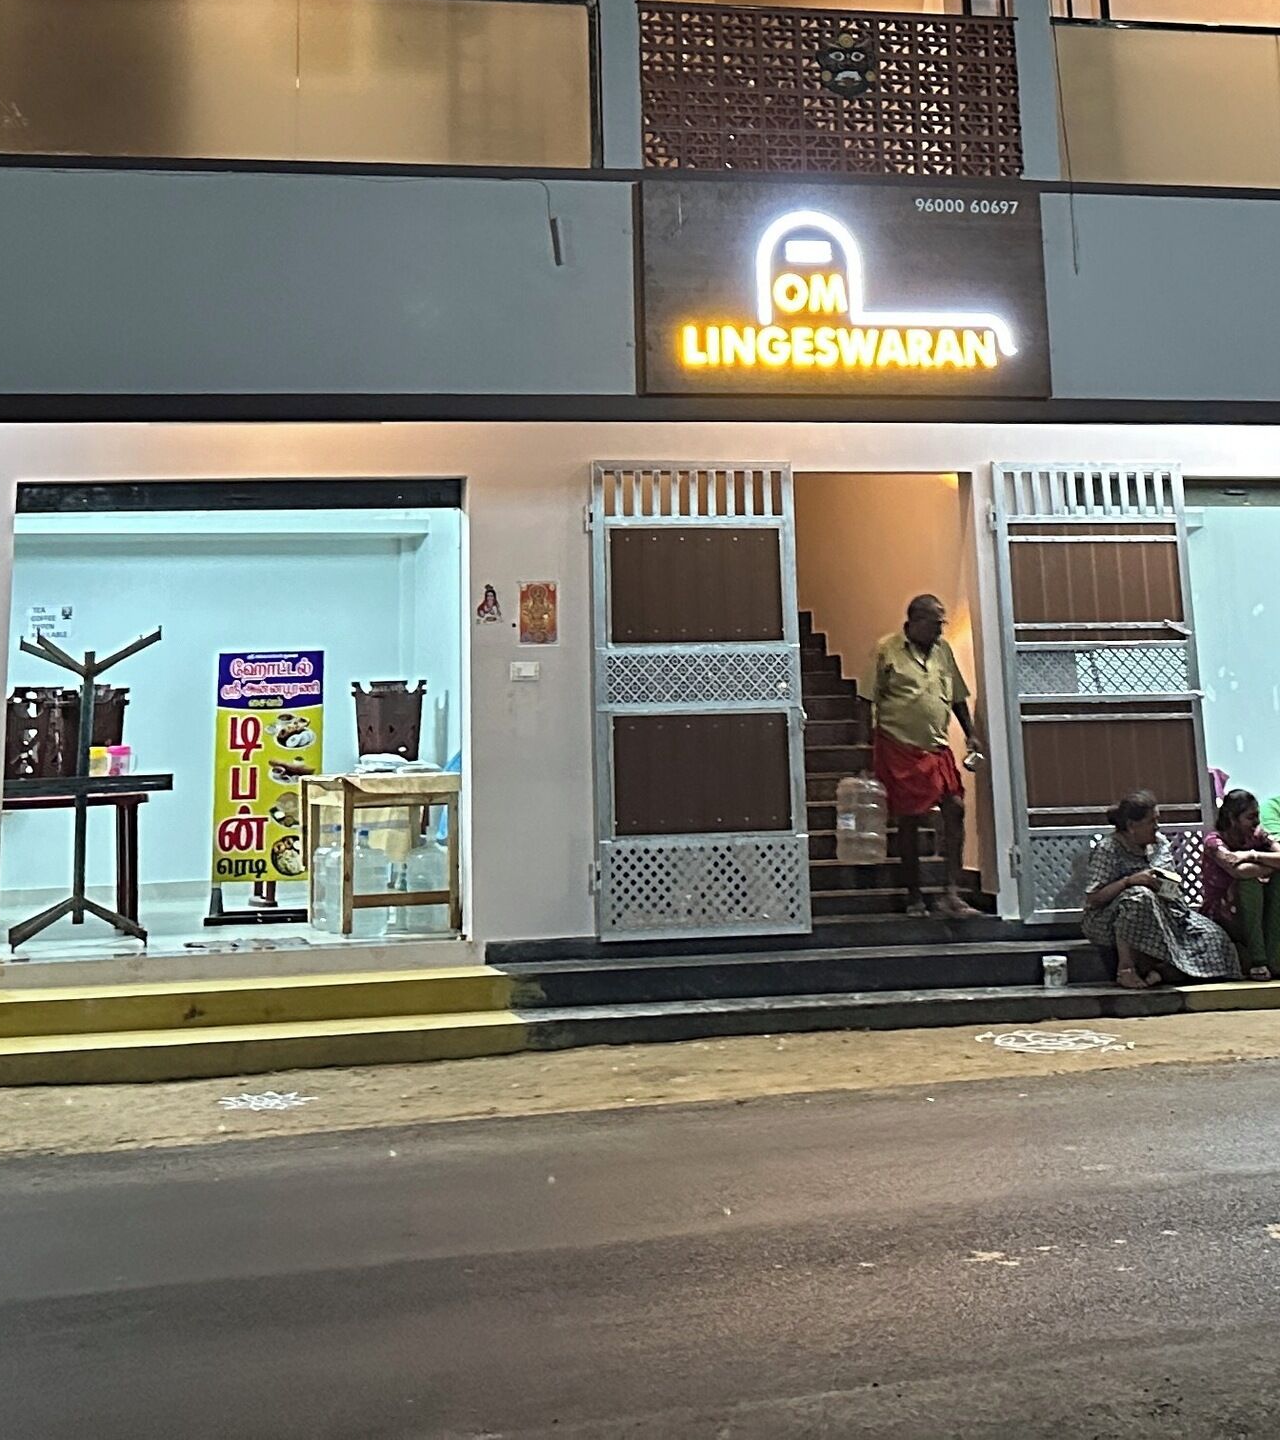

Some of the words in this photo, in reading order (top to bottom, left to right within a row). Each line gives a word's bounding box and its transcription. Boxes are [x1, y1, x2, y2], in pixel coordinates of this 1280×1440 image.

[915, 198, 965, 213] 96000
[970, 199, 1018, 215] 60697
[773, 272, 848, 314] OM
[681, 325, 999, 369] LINGESWARAN
[231, 658, 312, 682] ஹோட்டல்
[216, 858, 268, 878] ரெடி
